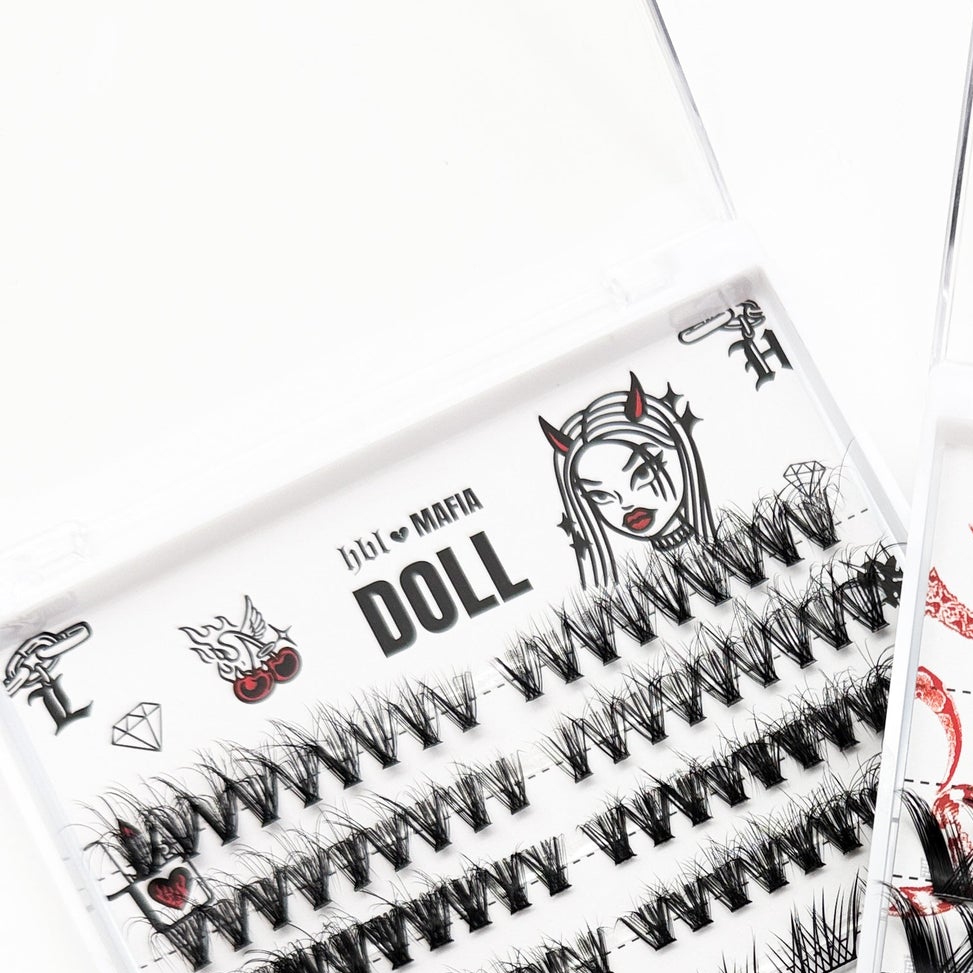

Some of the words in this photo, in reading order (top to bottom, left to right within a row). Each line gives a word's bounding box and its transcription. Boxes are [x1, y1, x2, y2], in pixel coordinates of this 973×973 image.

[337, 528, 390, 575] hbl
[410, 488, 482, 536] MAFIA
[352, 531, 533, 658] DOLL
